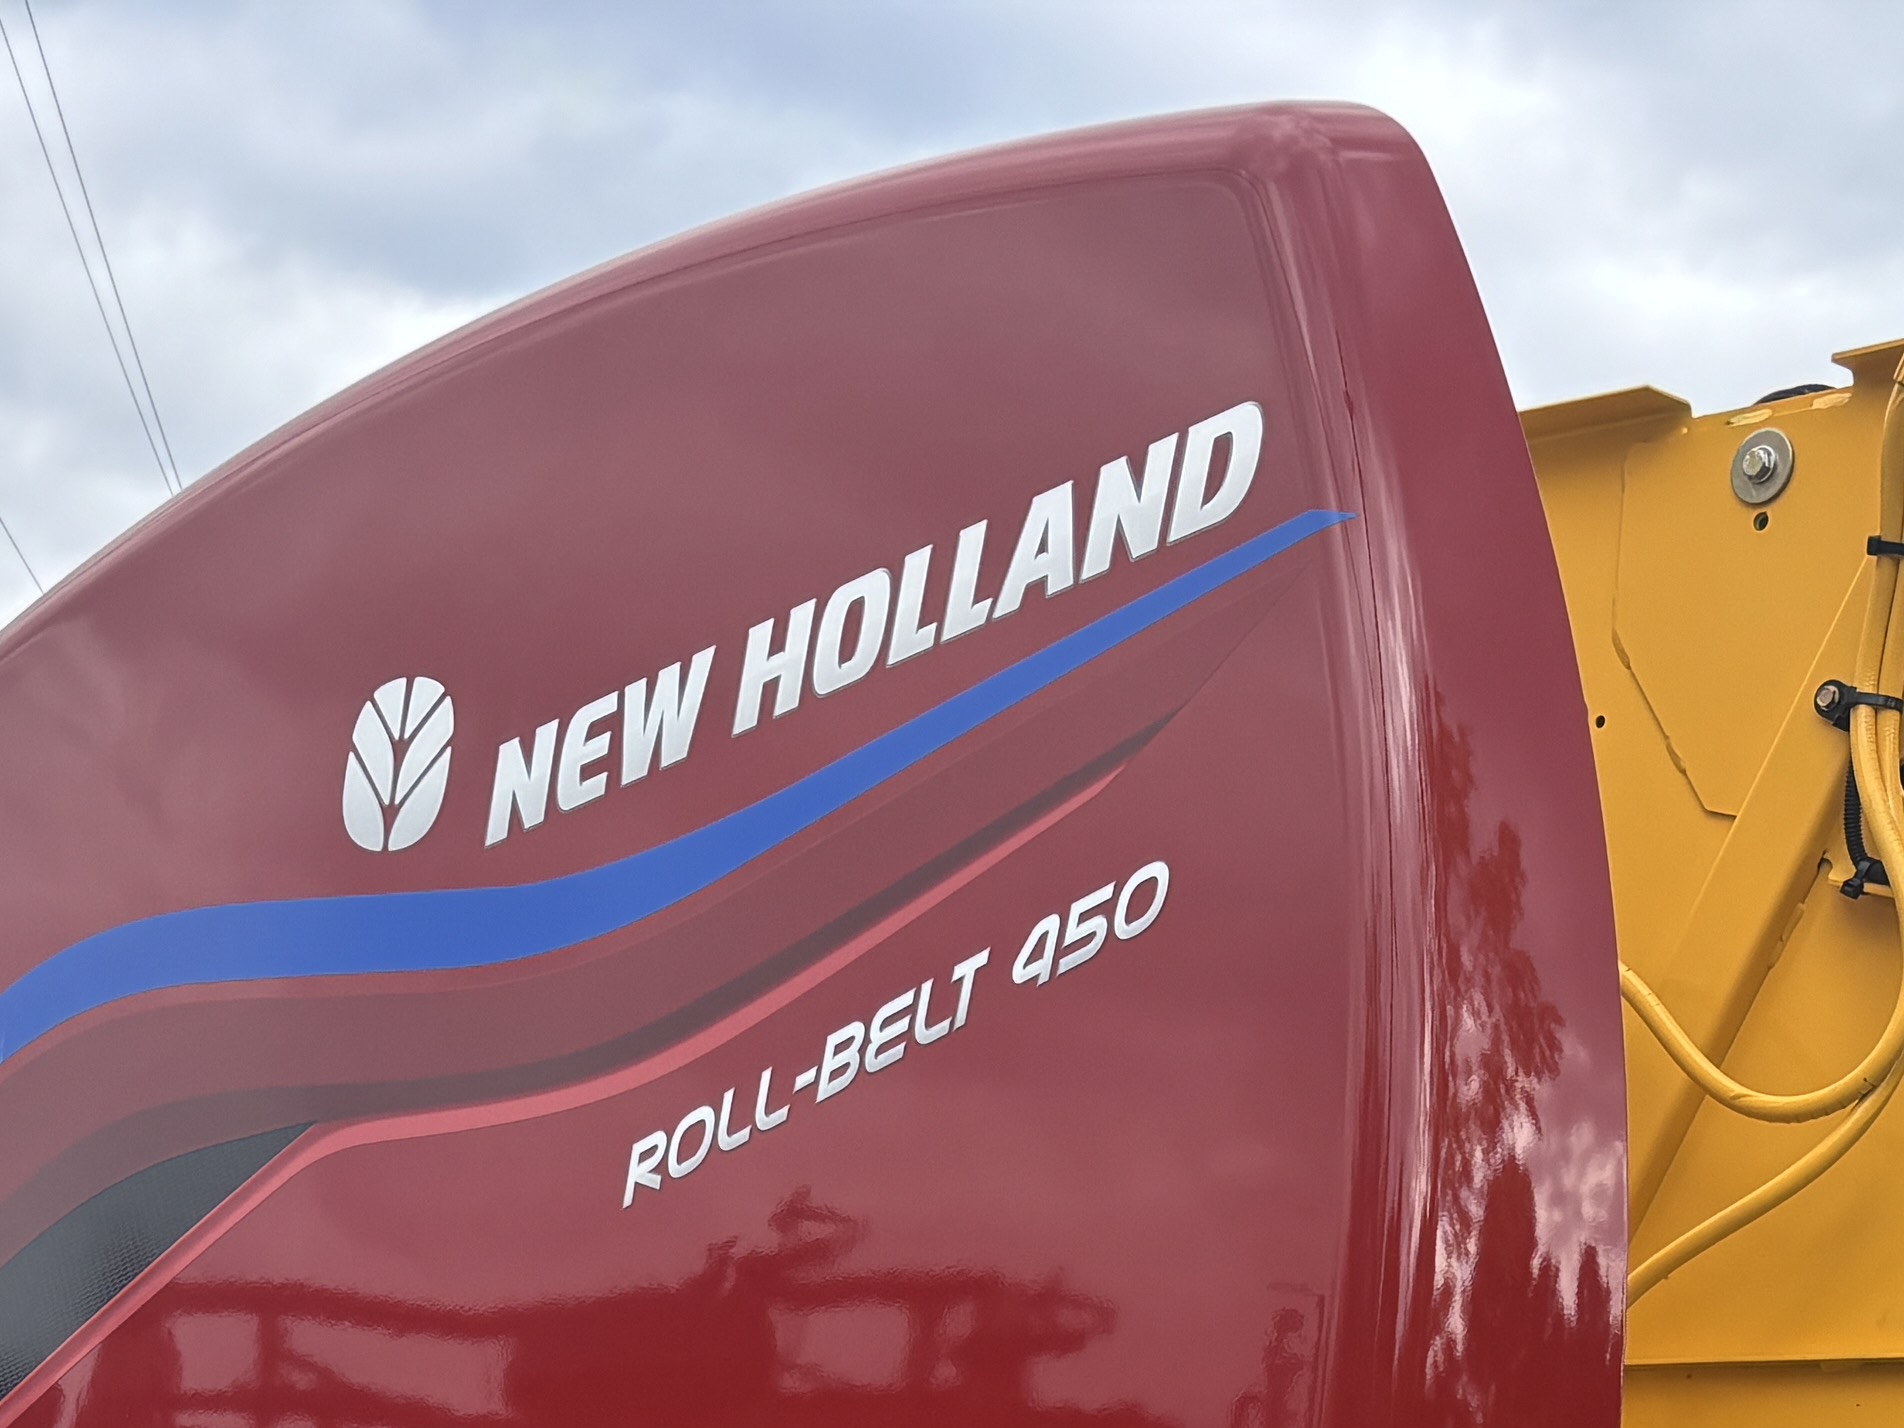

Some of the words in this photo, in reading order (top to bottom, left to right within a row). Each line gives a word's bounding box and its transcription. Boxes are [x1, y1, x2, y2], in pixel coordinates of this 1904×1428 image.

[483, 643, 717, 850] NEW
[730, 398, 1266, 739] HOLLAND
[621, 948, 991, 1211] ROLL-BELT
[1010, 859, 1171, 989] 450
